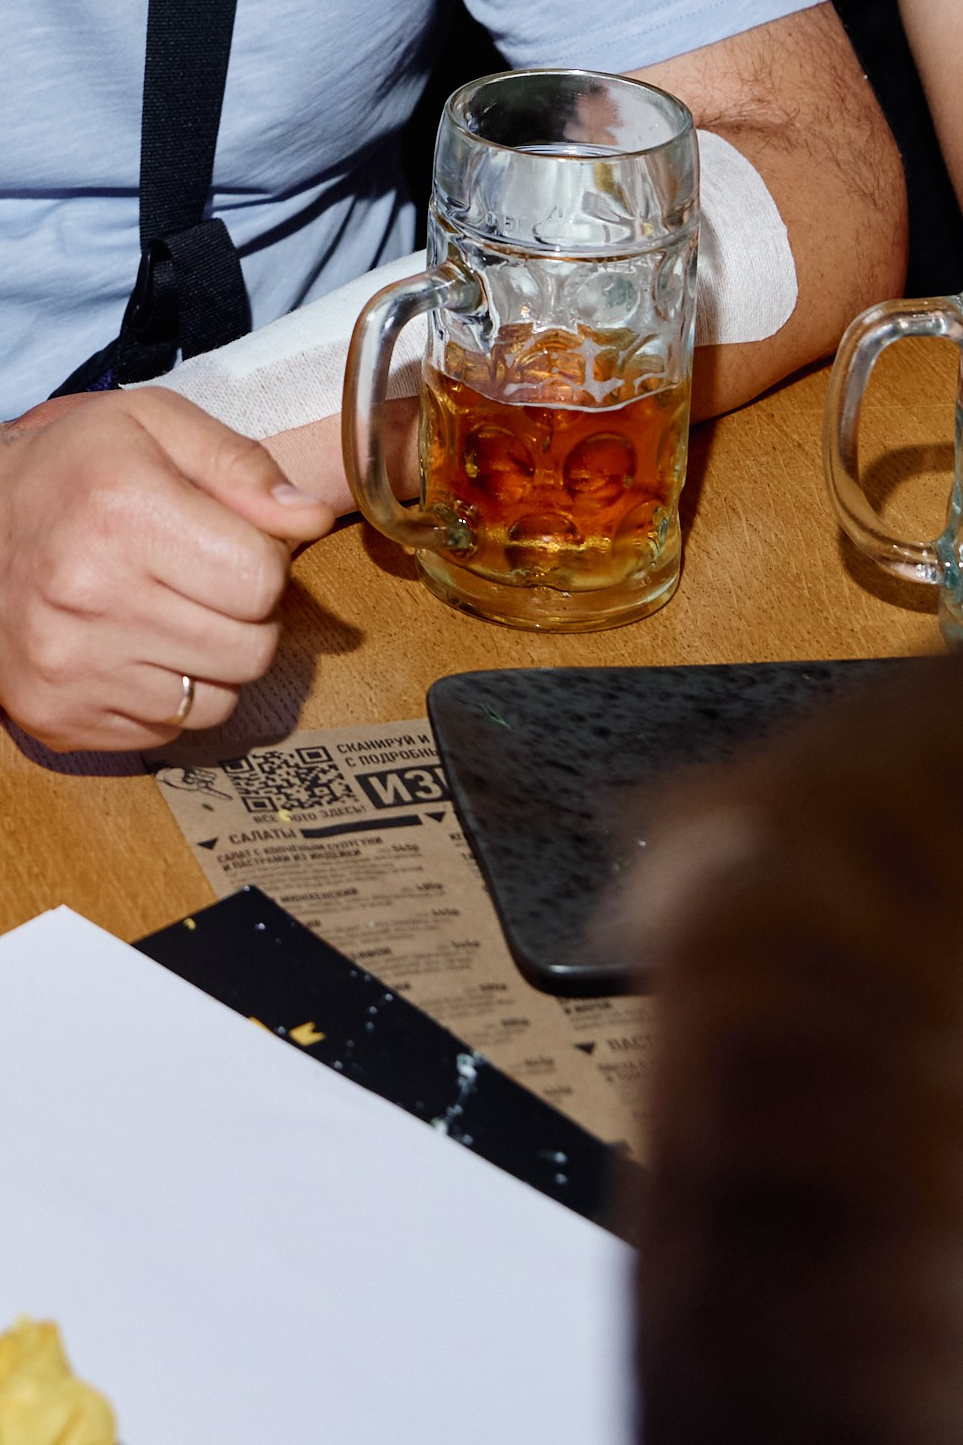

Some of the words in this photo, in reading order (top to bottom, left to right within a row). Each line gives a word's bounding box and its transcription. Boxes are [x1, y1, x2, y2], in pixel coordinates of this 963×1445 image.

[336, 734, 416, 754] СКАНИРУЙ
[417, 734, 430, 743] И
[345, 756, 356, 767] С
[229, 827, 297, 845] САЛАТЫ
